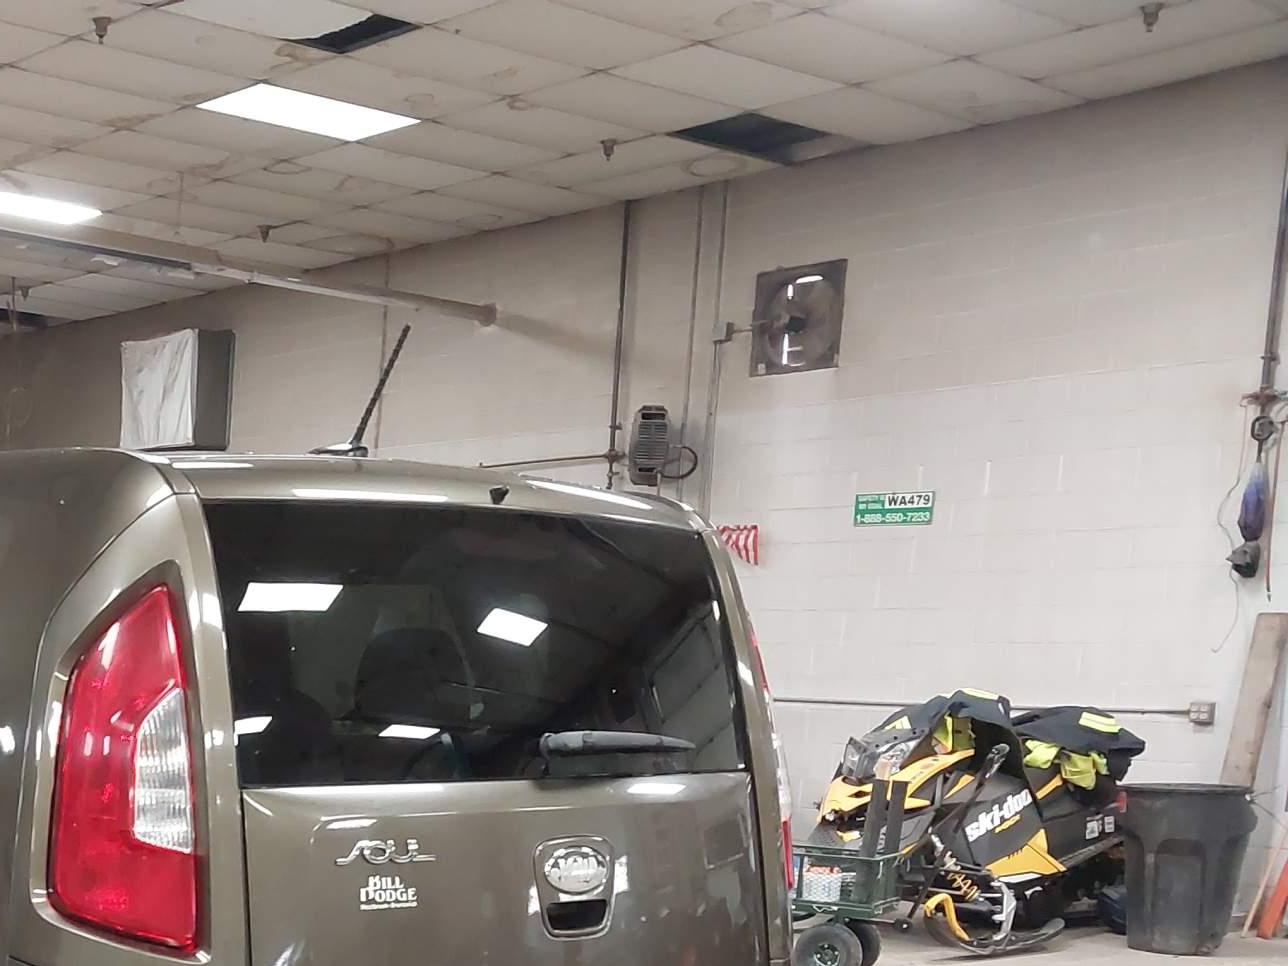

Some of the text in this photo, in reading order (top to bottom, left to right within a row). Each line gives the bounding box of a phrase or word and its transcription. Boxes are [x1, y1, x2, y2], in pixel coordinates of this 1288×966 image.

[887, 494, 931, 506] WA479
[368, 875, 404, 889] BILL
[360, 887, 417, 902] DODGE
